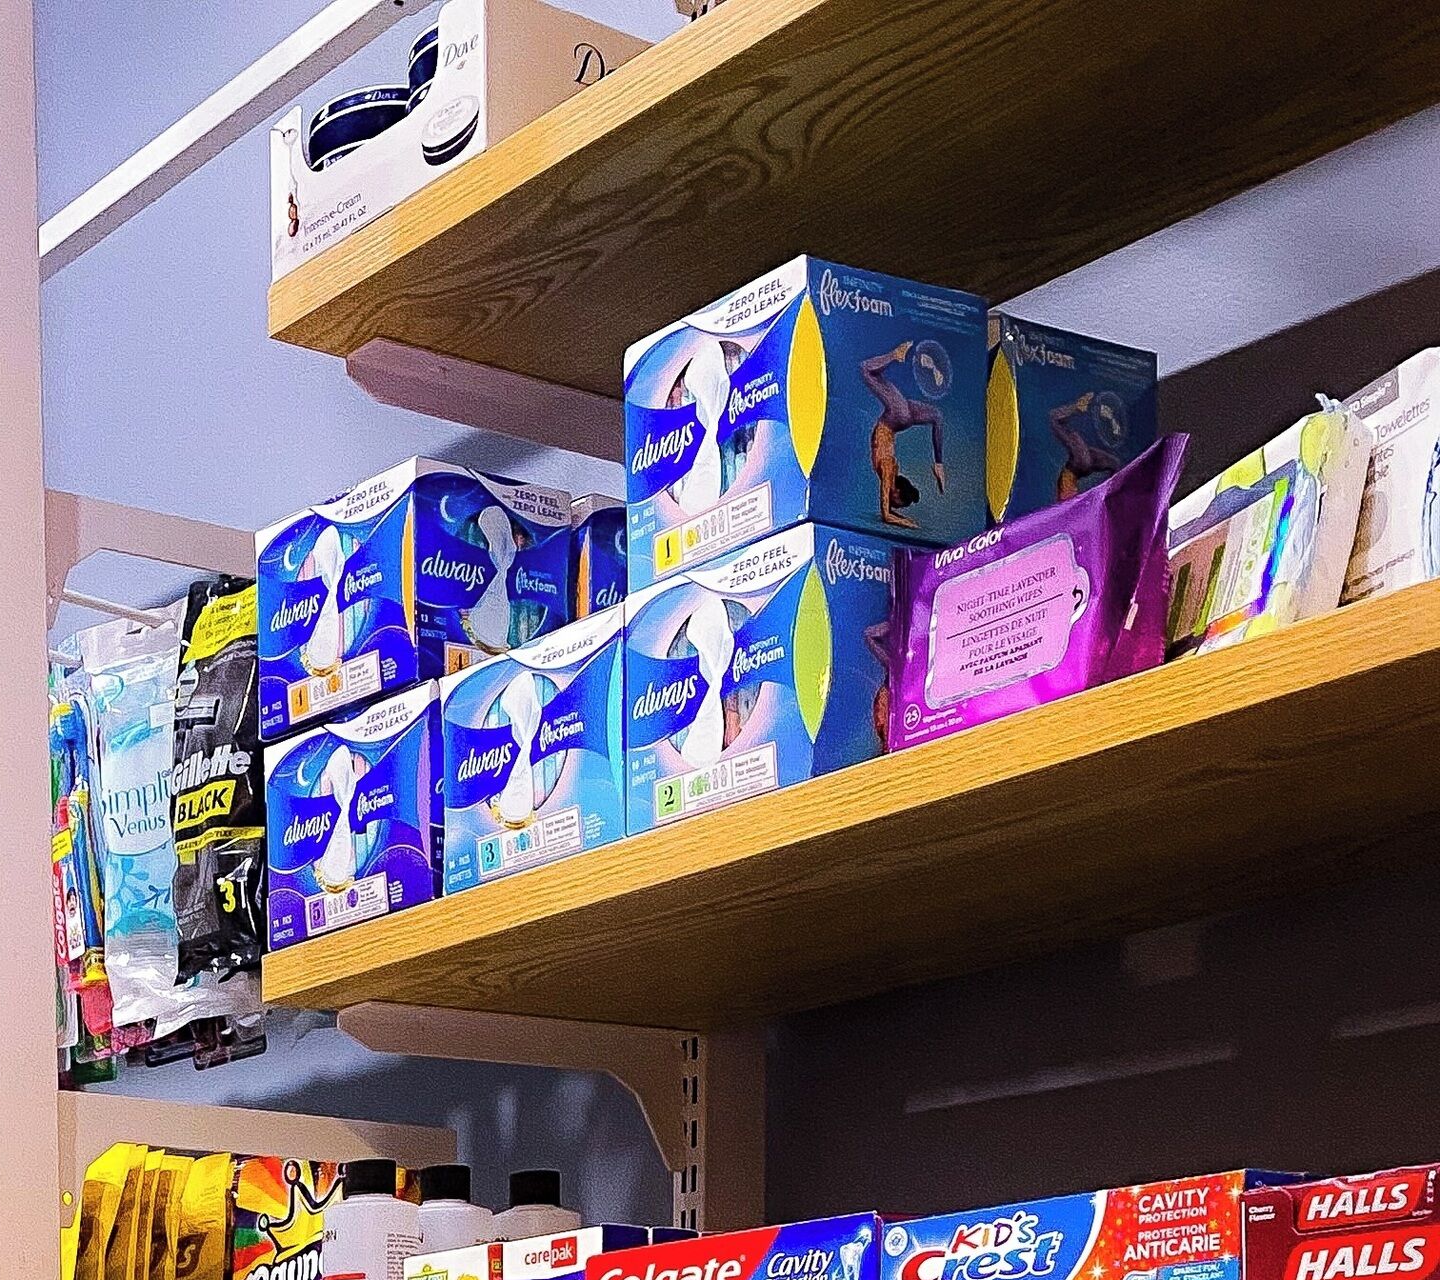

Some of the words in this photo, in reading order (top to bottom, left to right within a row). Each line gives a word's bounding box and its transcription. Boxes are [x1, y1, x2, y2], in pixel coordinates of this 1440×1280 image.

[728, 292, 756, 313] ZERO
[757, 277, 783, 304] FEEL
[725, 309, 752, 329] ZERO
[1375, 398, 1431, 440] Towelettes
[632, 421, 695, 474] always
[346, 488, 366, 504] ZERO
[367, 480, 388, 498] FEEL
[343, 503, 364, 520] ZERO
[732, 556, 759, 575] ZERO
[760, 543, 789, 563] FEEL
[934, 547, 964, 569] Viva
[968, 528, 1005, 554] Color
[422, 551, 486, 584] always
[730, 571, 757, 590] ZERO
[270, 593, 319, 632] always
[633, 673, 698, 720] always
[366, 708, 385, 724] ZERO
[386, 701, 407, 717] FEEL
[172, 746, 250, 795] Gillette
[458, 741, 512, 781] always
[177, 787, 227, 818] BLACK
[663, 786, 674, 806] 2
[110, 812, 166, 837] Venus
[283, 808, 331, 847] always
[484, 843, 495, 864] 3
[218, 880, 236, 912] 3
[1137, 1186, 1210, 1214] CAVITY
[1306, 1183, 1409, 1222] HALLS
[952, 1209, 1038, 1254] KID'S
[1137, 1206, 1208, 1226] PROTECTION
[1123, 1233, 1221, 1263] ANTICARIE
[1137, 1223, 1208, 1243] PROTECTION
[766, 1249, 834, 1279] Cavity
